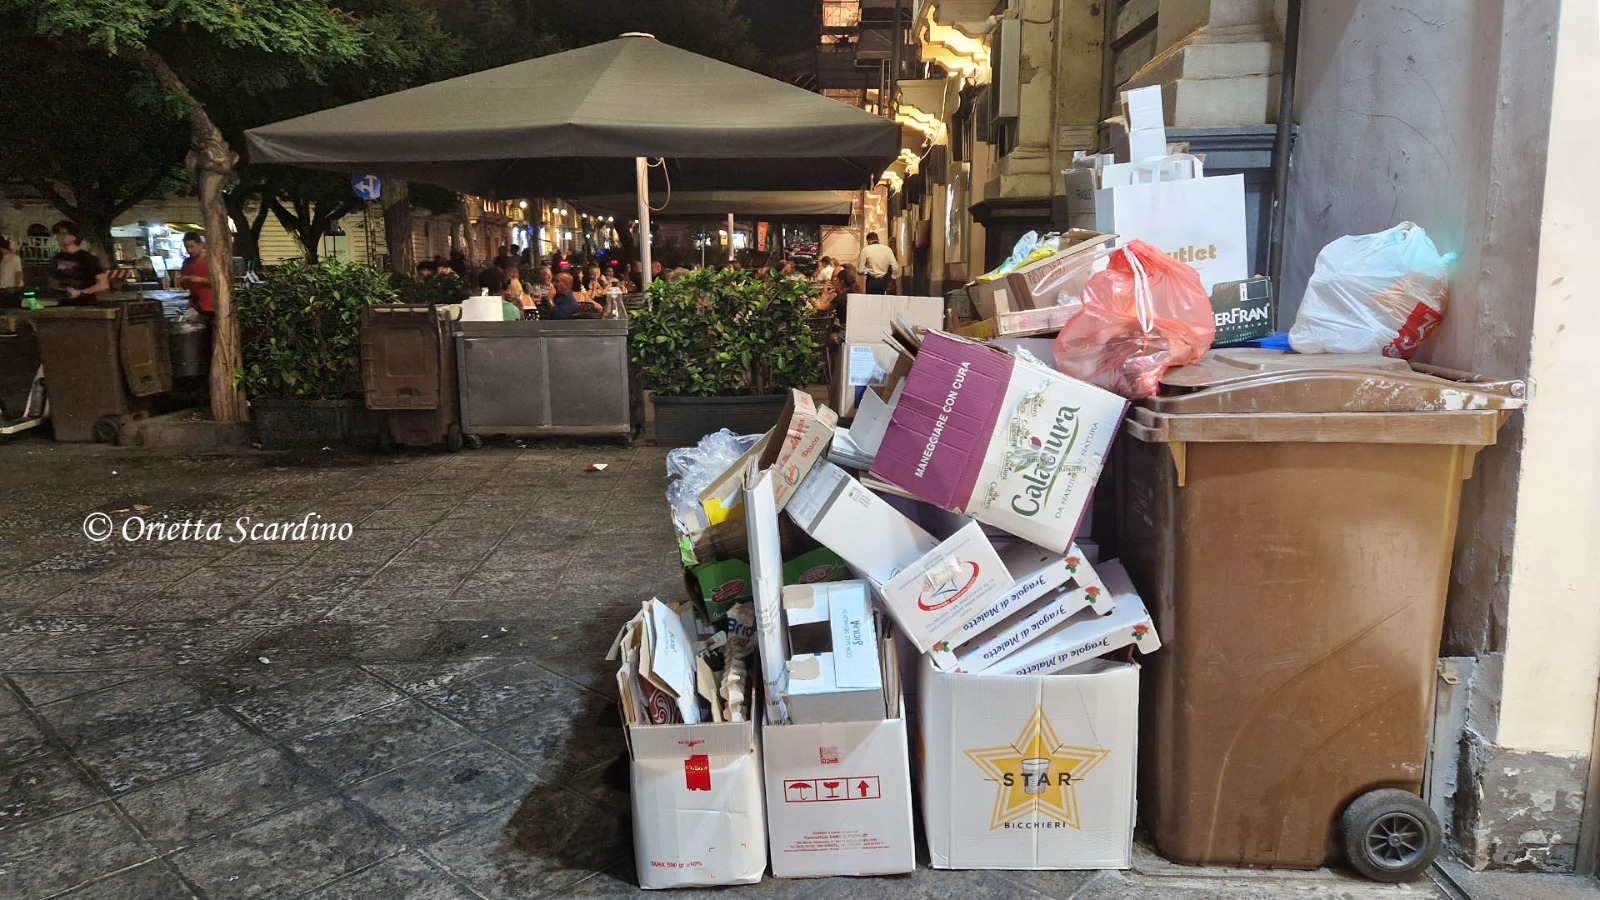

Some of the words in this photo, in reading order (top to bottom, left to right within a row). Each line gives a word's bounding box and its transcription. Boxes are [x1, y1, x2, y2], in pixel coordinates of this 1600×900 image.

[1211, 306, 1269, 327] ERFRAN
[914, 413, 949, 479] MANEGGIARE
[944, 386, 959, 414] CON
[952, 361, 971, 390] CURA
[1080, 421, 1099, 457] NATURA
[1060, 470, 1079, 506] NATUR
[1054, 504, 1067, 519] DA
[1011, 575, 1047, 601] Fragole
[1000, 599, 1010, 608] di
[963, 605, 1000, 631] Maletto
[1032, 604, 1067, 631] Fragole
[850, 619, 864, 646] SICILIA
[1020, 628, 1030, 638] di
[983, 634, 1020, 660] Maletto
[1071, 637, 1110, 658] Fragole
[1016, 658, 1057, 676] Maletto
[1058, 654, 1068, 663] di
[1003, 772, 1073, 787] STAR
[1004, 821, 1067, 830] BICCHIERI
